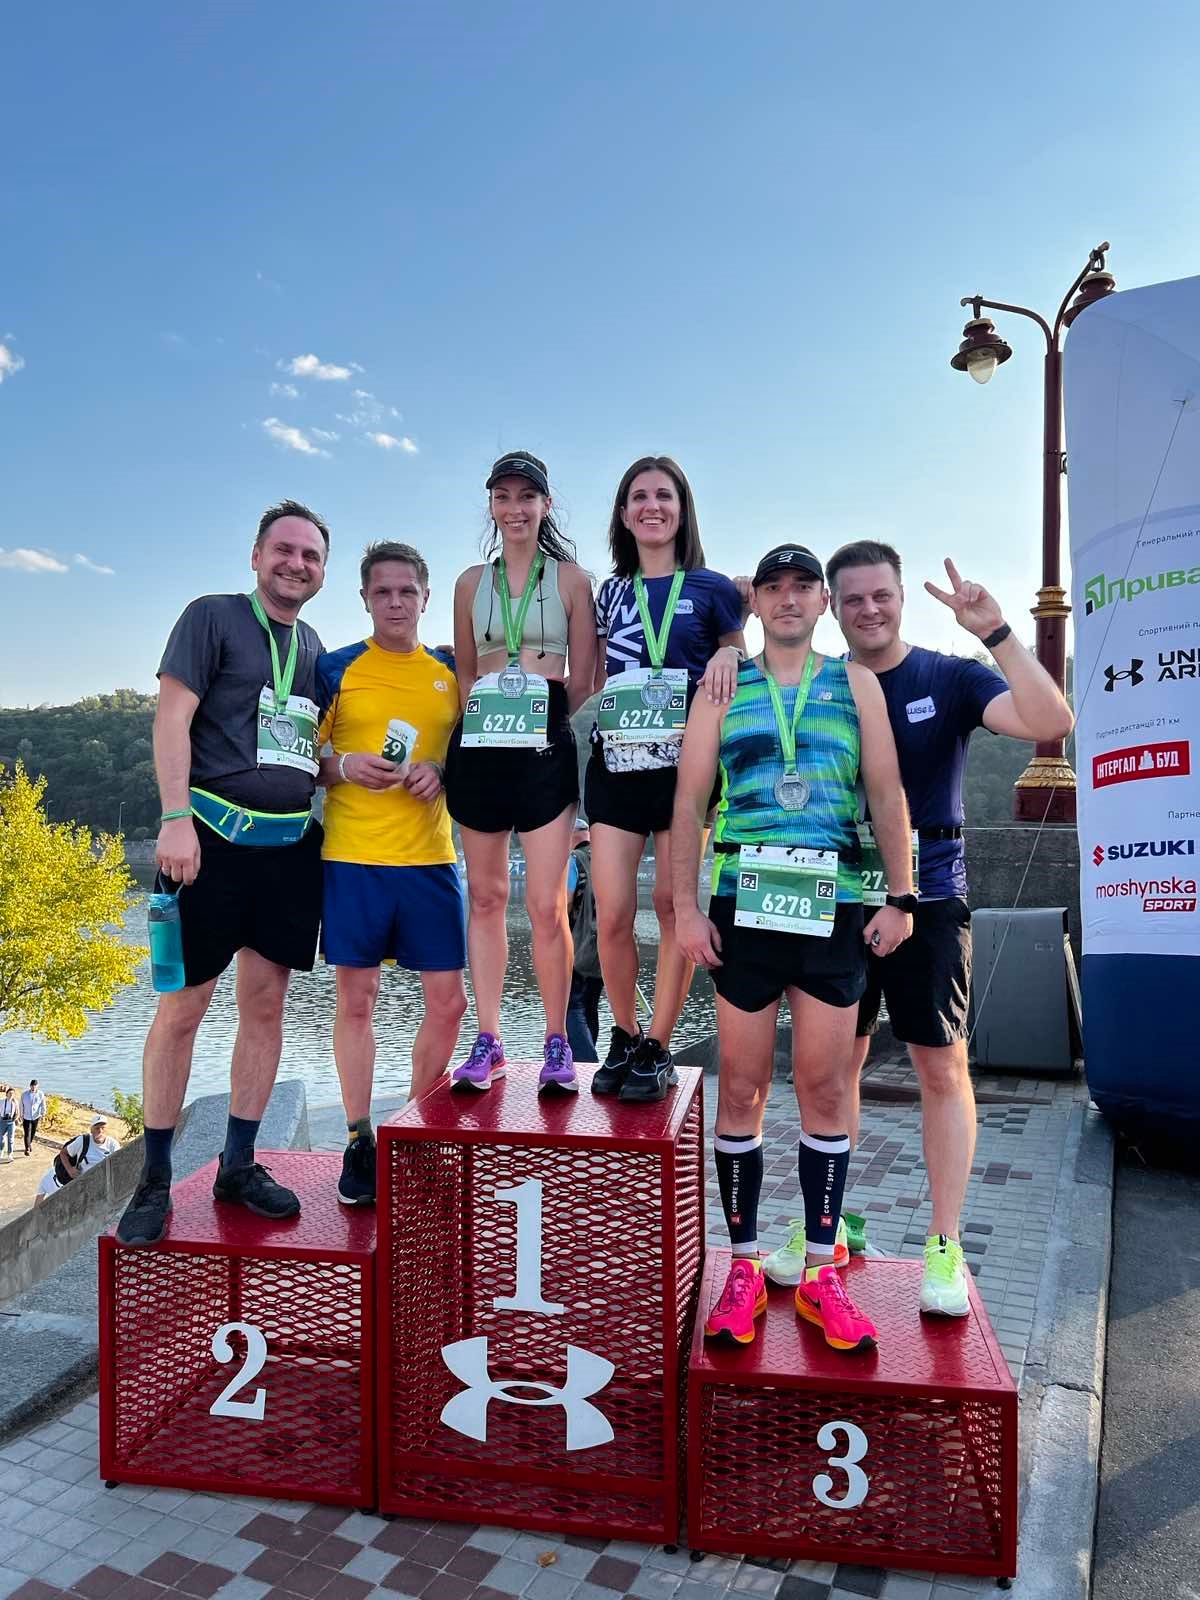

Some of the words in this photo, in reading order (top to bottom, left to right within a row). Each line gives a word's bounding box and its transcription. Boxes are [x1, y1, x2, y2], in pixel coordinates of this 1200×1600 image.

[1138, 621, 1190, 637] Спортивний
[1158, 648, 1200, 666] UN
[1157, 663, 1200, 682] AR
[482, 714, 527, 733] 6276
[619, 709, 665, 729] 6274
[1156, 717, 1166, 727] 21
[1096, 756, 1136, 780] ІНТЕРГАЛ
[1156, 751, 1180, 768] БУД
[1107, 839, 1195, 861] SUZUKI
[1096, 876, 1197, 899] morshynska
[761, 893, 812, 918] 6278
[1144, 899, 1195, 911] SPORT
[731, 1159, 741, 1214] COMPRESPORT
[492, 1178, 565, 1315] 1
[209, 1321, 268, 1422] 2
[812, 1420, 870, 1510] 3
